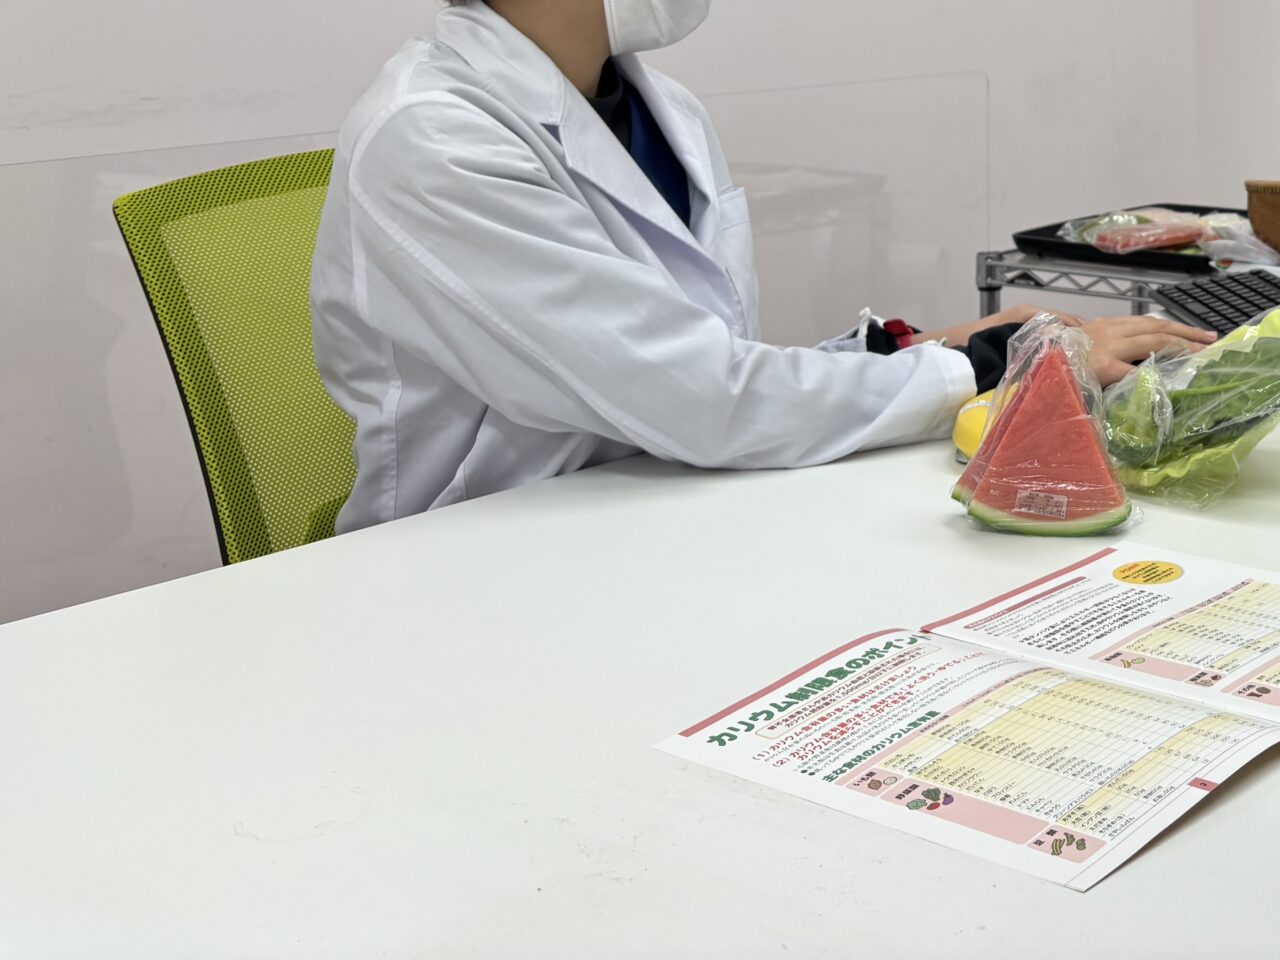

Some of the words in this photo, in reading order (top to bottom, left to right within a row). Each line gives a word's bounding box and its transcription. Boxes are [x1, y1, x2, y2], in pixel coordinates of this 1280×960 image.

[707, 634, 931, 747] カリウム制限食のポイント
[752, 750, 770, 761] (1)
[769, 666, 917, 752] カリウム含有量の多い食材はさけましょう
[772, 757, 790, 768] (2)
[821, 710, 941, 782] 主な食材のカリウム含有量
